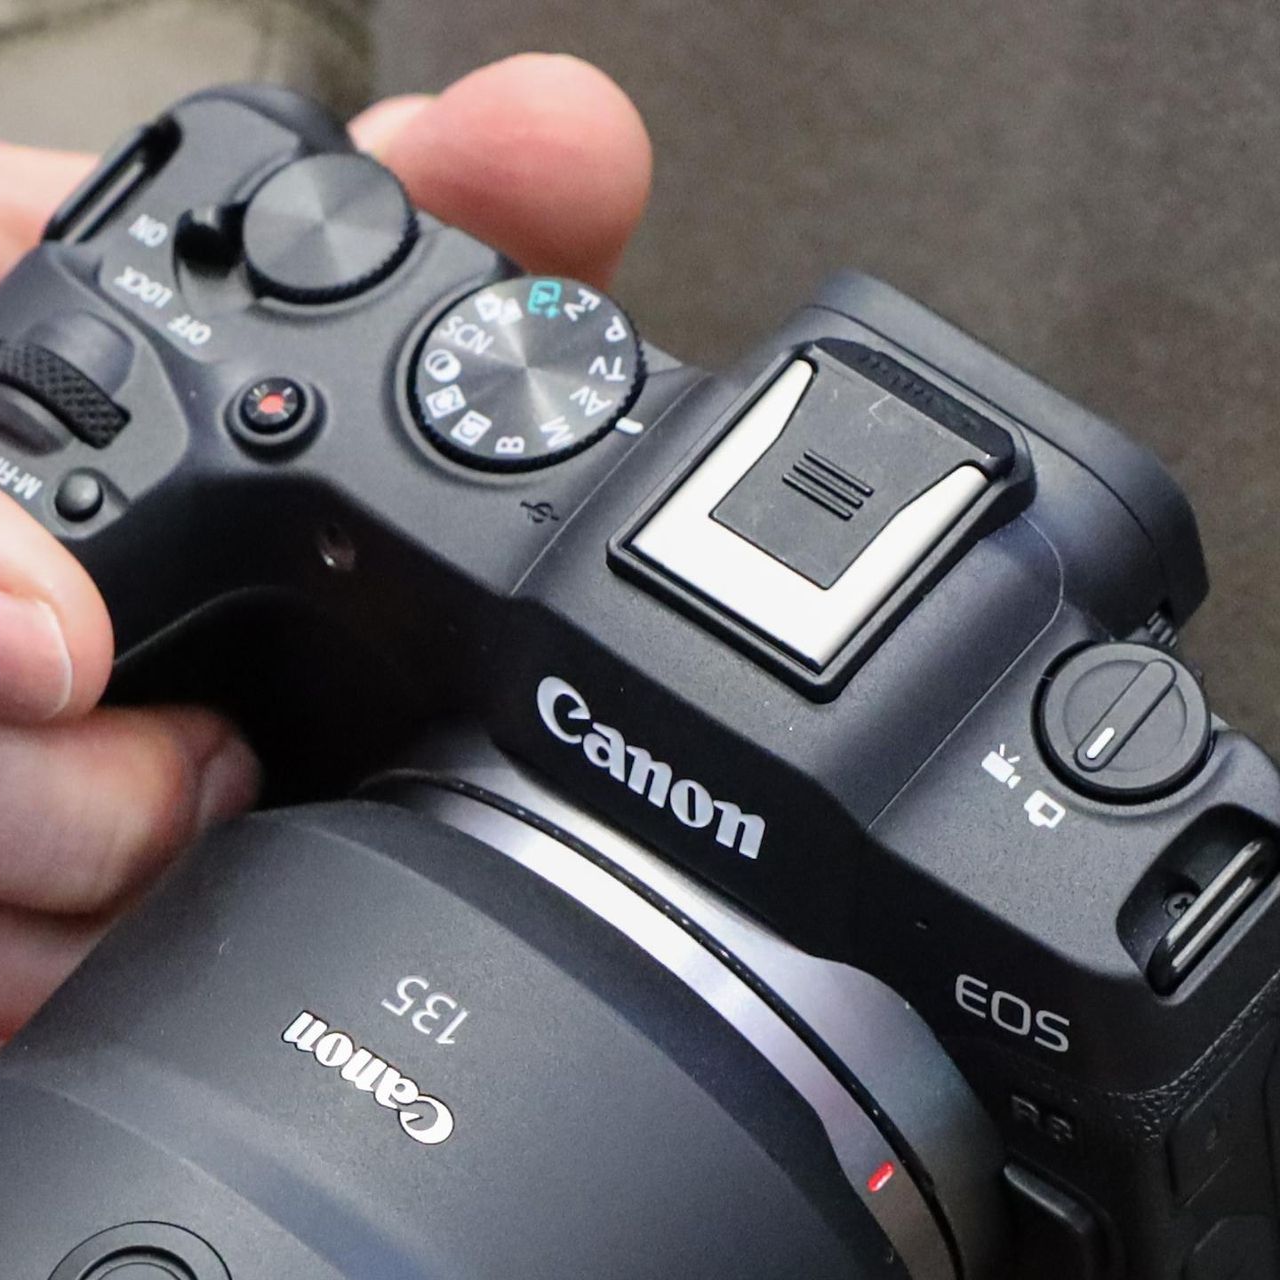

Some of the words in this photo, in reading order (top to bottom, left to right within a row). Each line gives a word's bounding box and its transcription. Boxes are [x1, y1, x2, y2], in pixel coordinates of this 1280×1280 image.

[128, 214, 168, 247] ON
[114, 265, 173, 308] LOCK
[564, 288, 601, 321] Fv
[166, 313, 211, 344] OFF
[440, 315, 494, 354] SCN
[605, 316, 627, 342] P
[588, 356, 626, 381] Tv
[569, 385, 613, 416] Av
[495, 436, 525, 454] B
[540, 416, 574, 448] M
[537, 676, 766, 860] Canon
[380, 975, 469, 1044] 135
[955, 974, 1070, 1052] EOS
[282, 1010, 455, 1145] Canon
